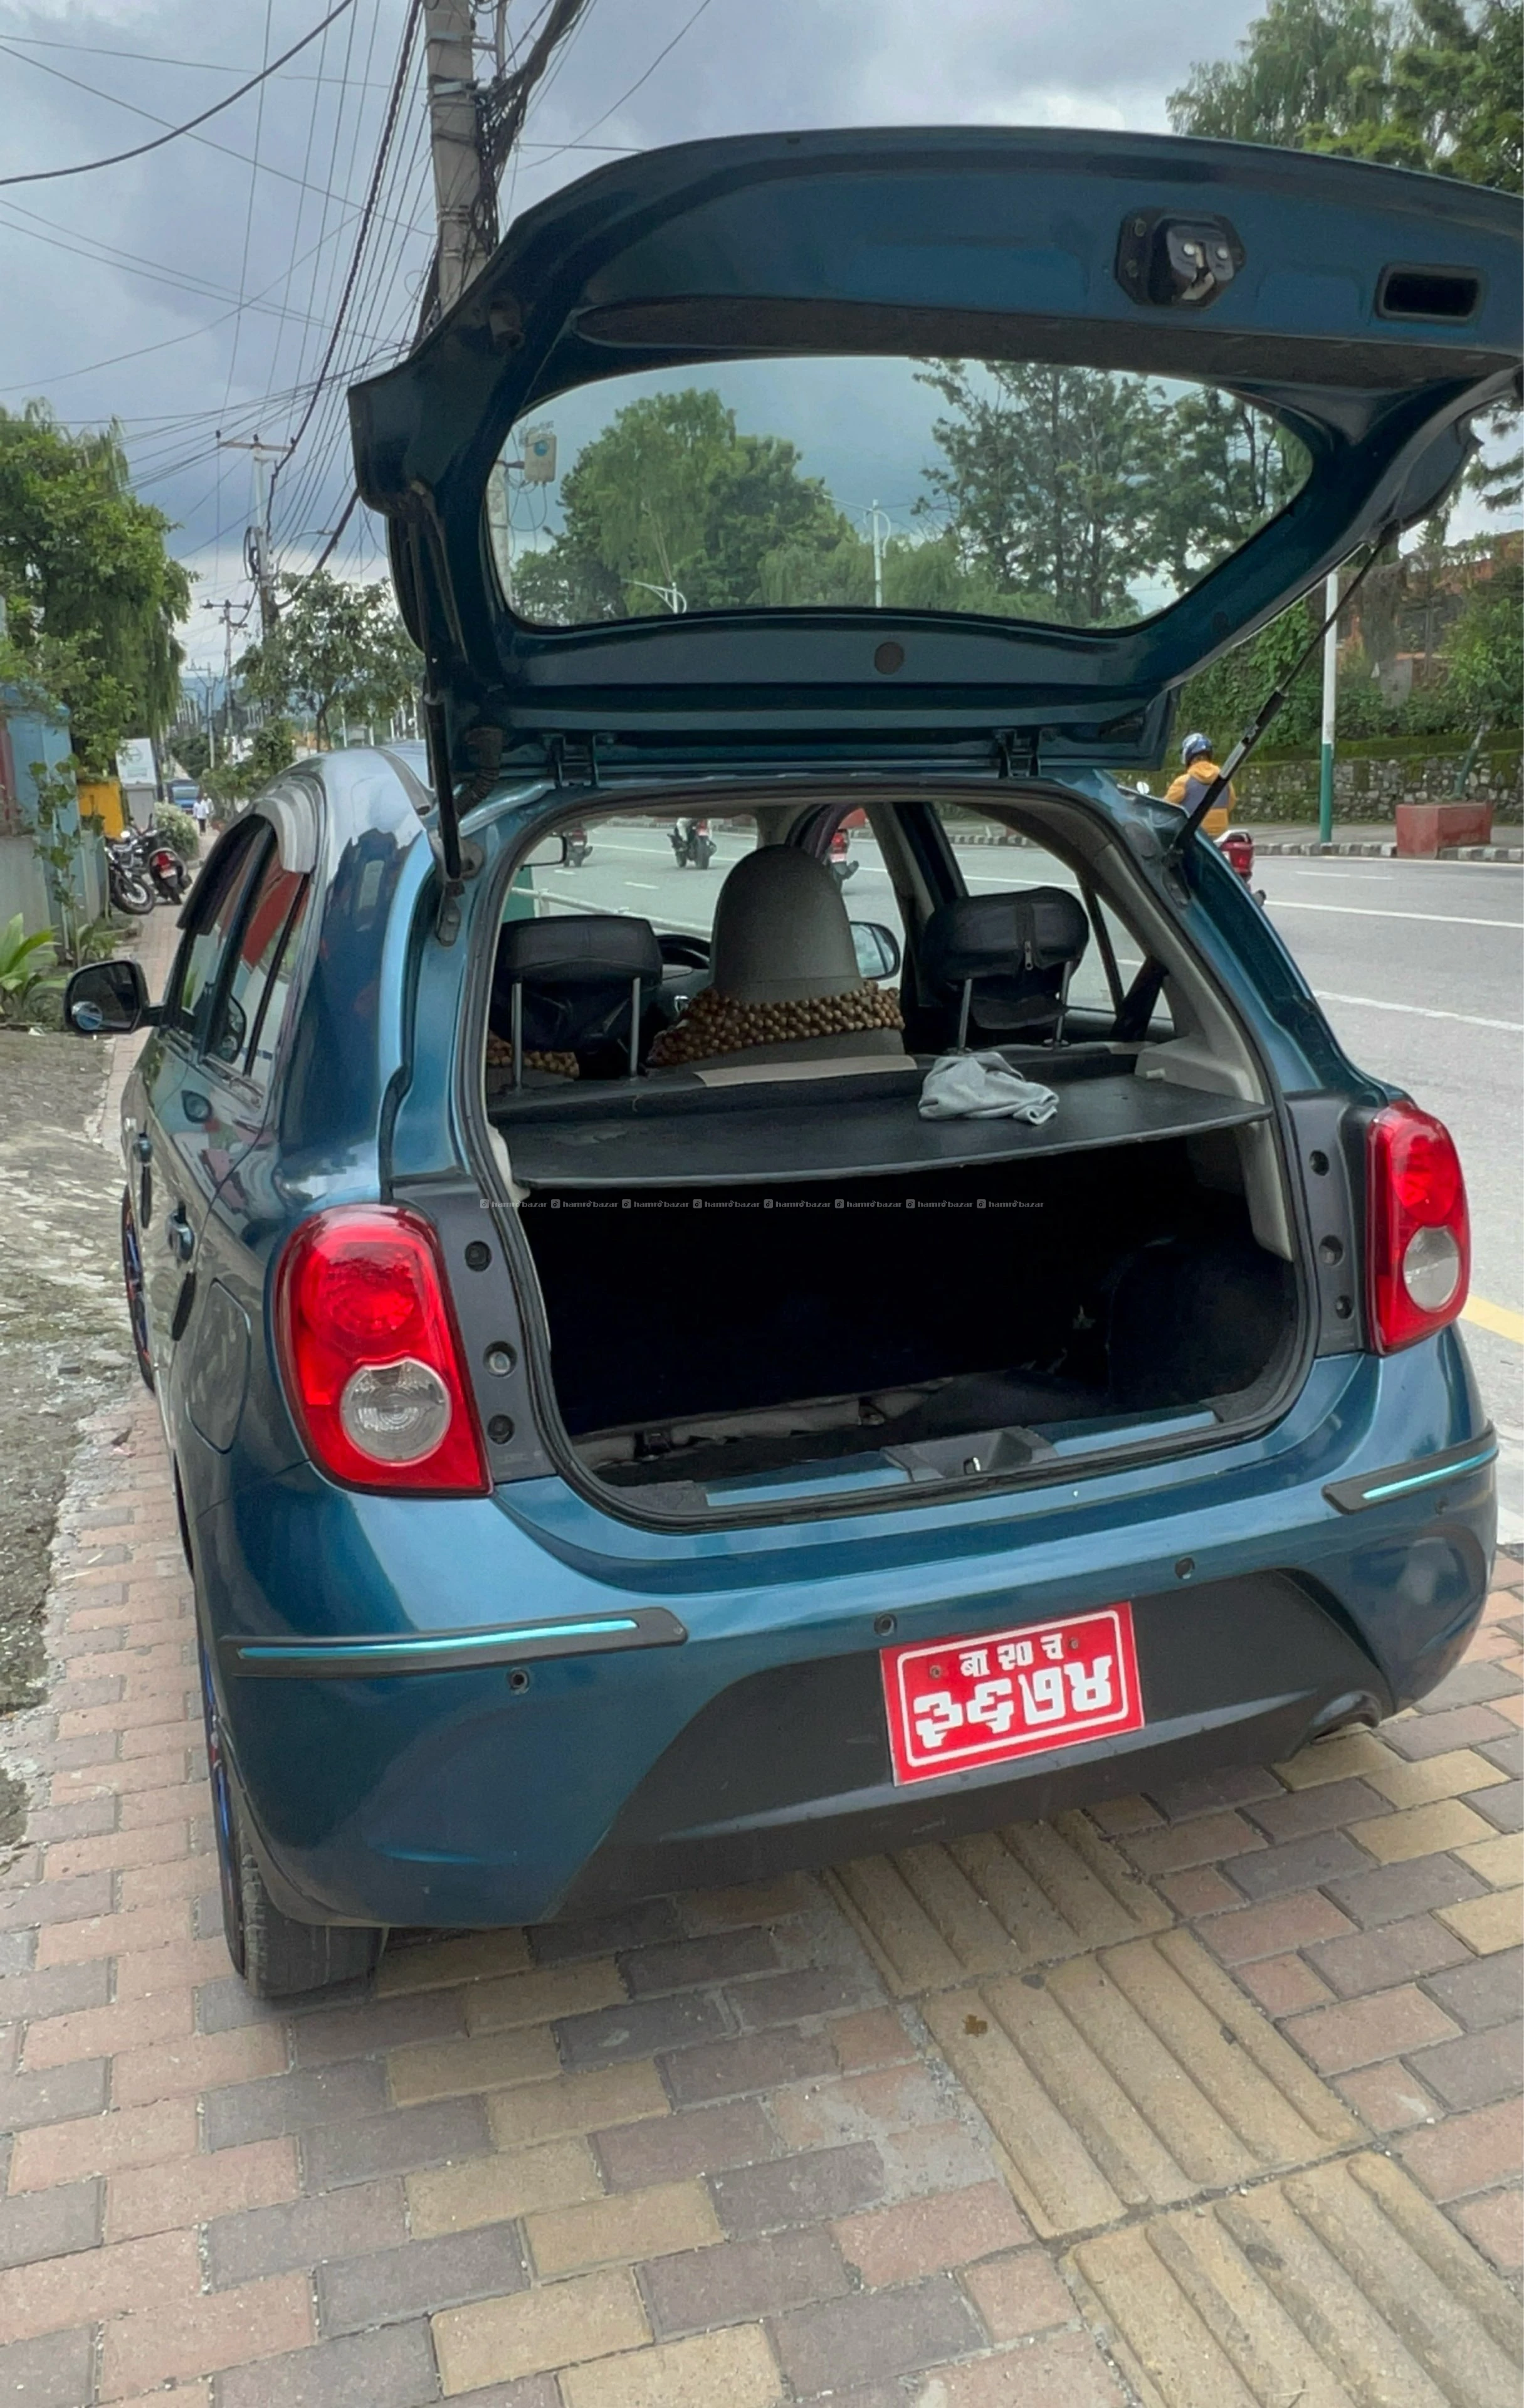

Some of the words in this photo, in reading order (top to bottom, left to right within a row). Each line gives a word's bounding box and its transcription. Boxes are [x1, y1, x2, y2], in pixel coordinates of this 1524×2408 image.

[959, 1649, 990, 1677] बा
[1041, 1634, 1064, 1659] च
[913, 1656, 1112, 1748] ३६७४
